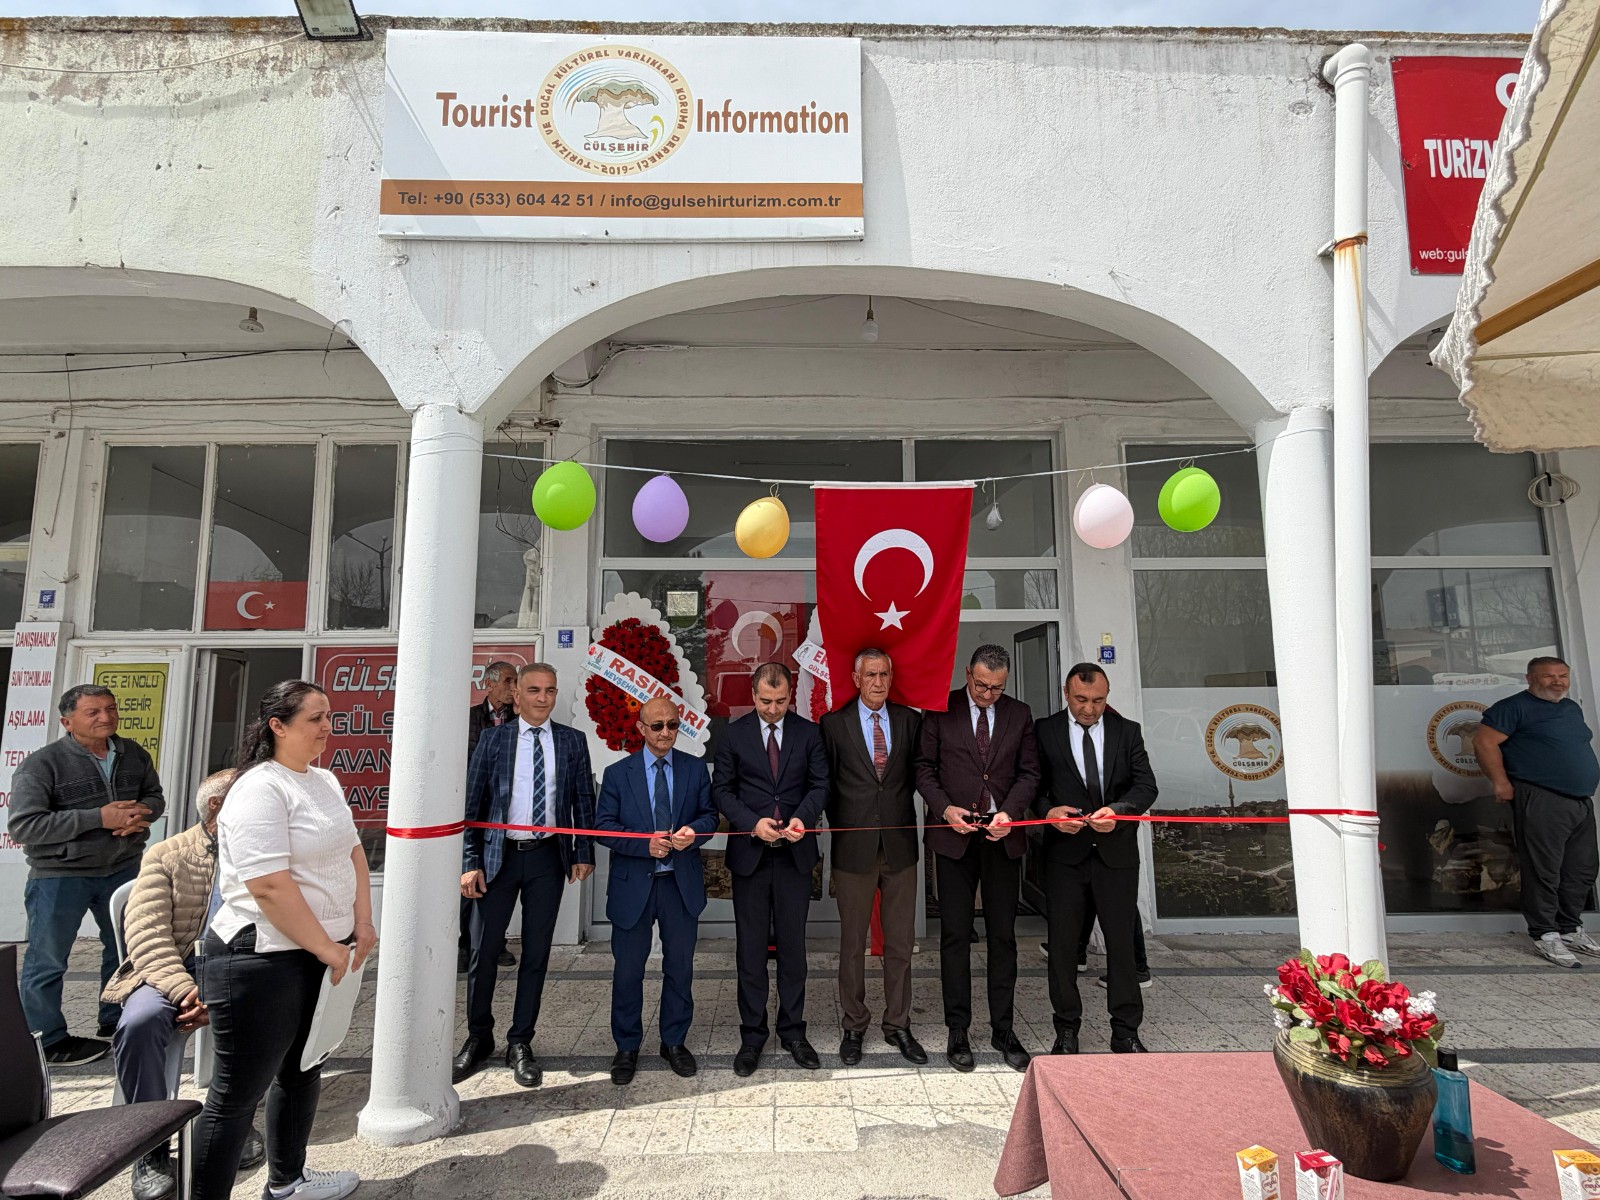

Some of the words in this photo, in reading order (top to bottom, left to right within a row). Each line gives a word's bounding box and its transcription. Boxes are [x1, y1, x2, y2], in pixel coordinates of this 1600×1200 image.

[554, 50, 610, 80] KÜLTÜREL
[617, 50, 679, 84] VARLIKLARI
[540, 83, 556, 116] DOĞAL
[675, 87, 689, 130] KORUMA
[436, 92, 534, 128] Tourist
[697, 99, 849, 134] Information
[542, 122, 554, 135] VE
[551, 139, 591, 170] TURİZM
[583, 141, 649, 152] GÜLŞEHİR
[398, 192, 428, 205] Tel:
[433, 193, 464, 205] +90
[469, 193, 511, 208] (533)
[516, 193, 546, 206] 604
[551, 194, 571, 206] 42
[576, 194, 594, 207] 51
[610, 193, 842, 210] info@gulsehirturizm.com.tr
[15, 632, 57, 651] DANIŞMANLIK
[122, 676, 130, 688] 21
[132, 675, 159, 688] NOLU
[603, 670, 639, 695] NEVŞEHİR
[608, 657, 672, 700] RASİM
[115, 694, 152, 712] LŞEHİR
[8, 710, 45, 730] AŞILAMA
[118, 717, 155, 729] TORLU
[341, 785, 389, 811] AYS
